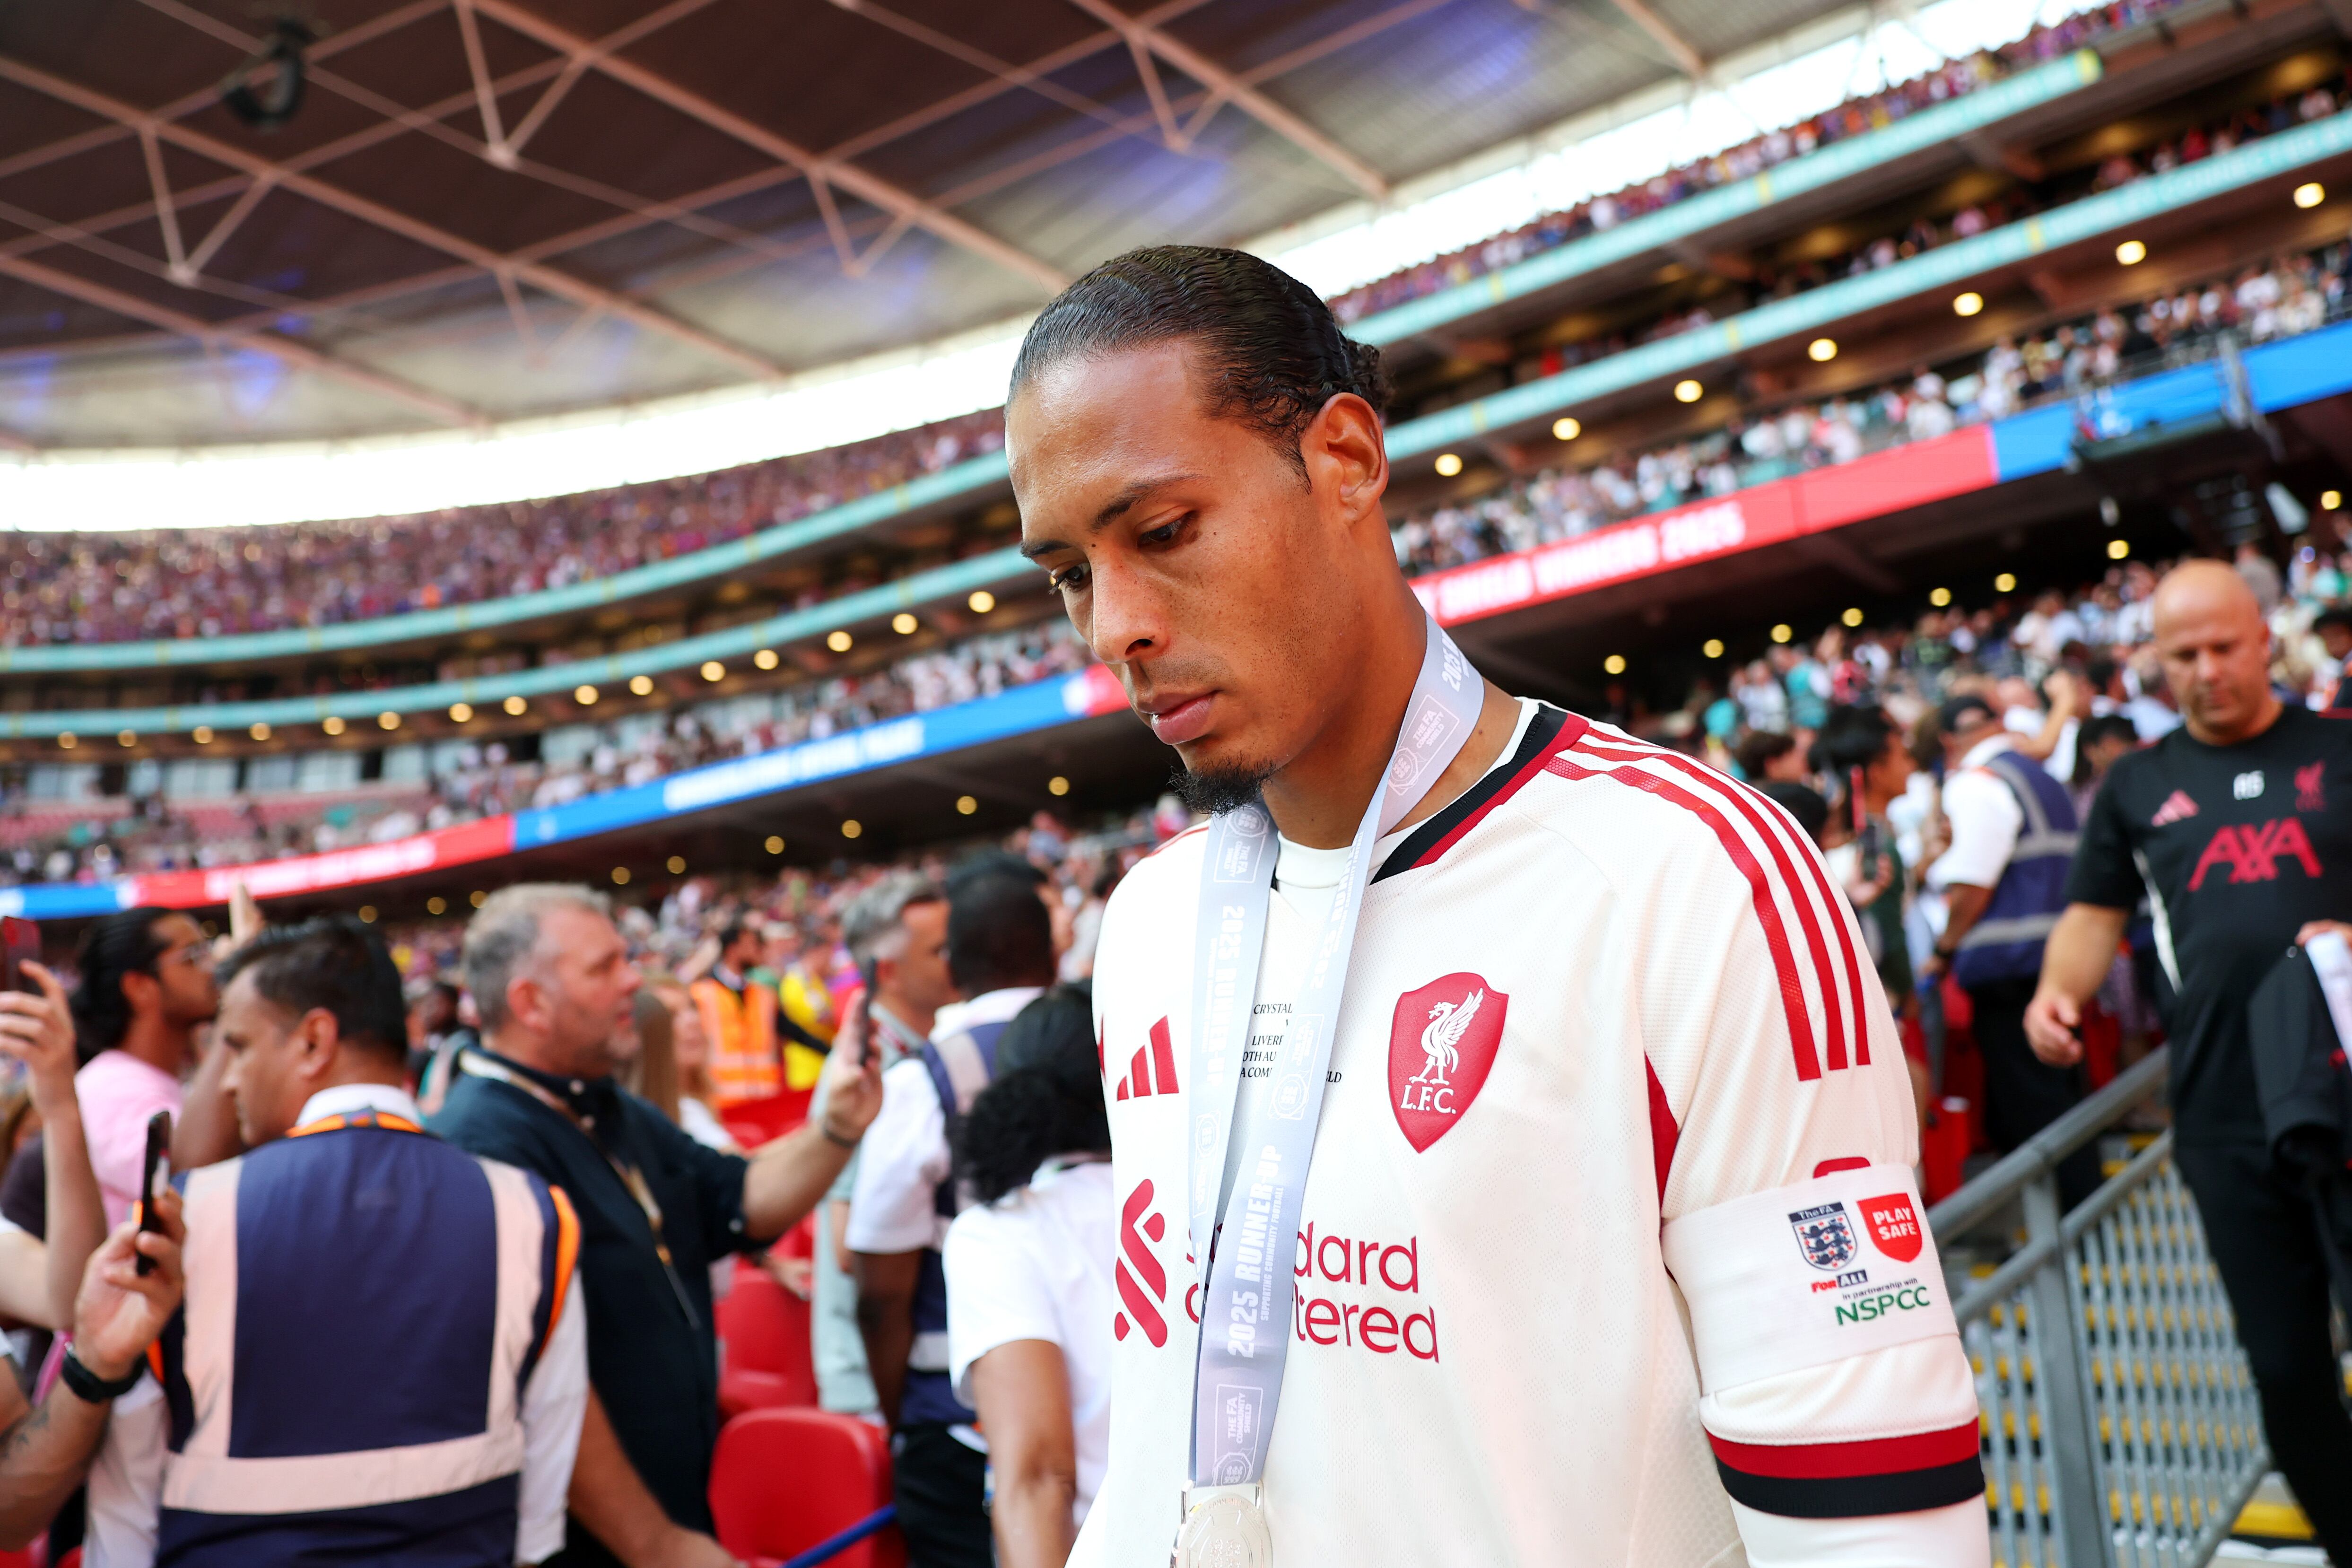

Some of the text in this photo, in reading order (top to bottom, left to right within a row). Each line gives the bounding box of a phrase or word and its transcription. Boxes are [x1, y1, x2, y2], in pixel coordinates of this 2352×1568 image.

[1660, 501, 1746, 563] 2025
[1413, 710, 1437, 740] THE FA
[1416, 711, 1445, 749] COMMUNITY
[1426, 723, 1445, 747] SHIELD
[1228, 840, 1243, 878] COMMUNITY
[1236, 845, 1251, 874] THE FA
[2187, 817, 2323, 892] AXA
[1309, 929, 1337, 991] 2025
[1206, 905, 1245, 1087] 2025 RUNNER-UP
[1254, 1003, 1293, 1014] CRYSTAL
[1872, 1207, 1912, 1226] PLAY
[1877, 1222, 1917, 1240] SAFE
[1227, 1144, 1283, 1358] 2025 RUNNER-UP
[1260, 1186, 1284, 1322] SUPPORTING COMMUNITY FOOTBALL
[1835, 1286, 1931, 1326] NSPCC
[1853, 1281, 1902, 1299] partnership
[1903, 1277, 1918, 1287] with
[1226, 1396, 1238, 1438] THE FA
[1236, 1392, 1246, 1444] COMMUNITY
[1243, 1403, 1252, 1434] SHIELD
